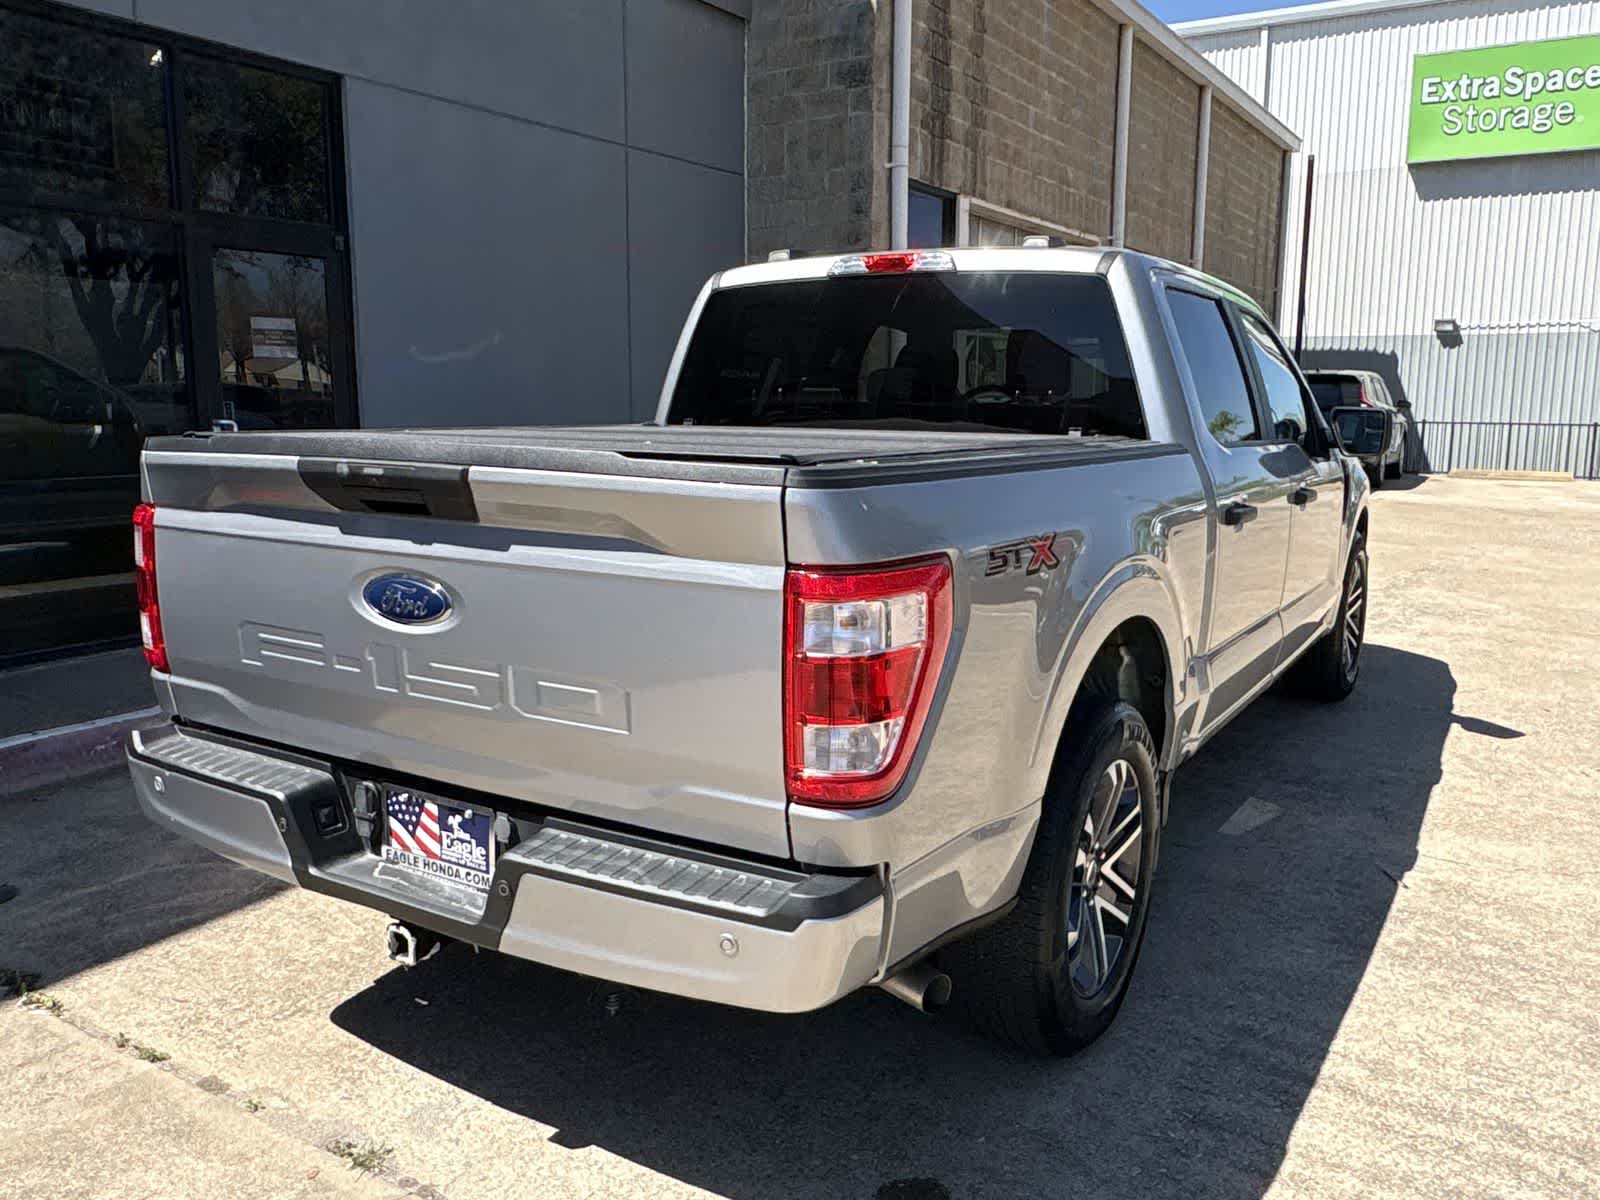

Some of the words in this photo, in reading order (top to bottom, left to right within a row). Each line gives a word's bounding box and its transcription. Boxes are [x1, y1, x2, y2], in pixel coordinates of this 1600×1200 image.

[1442, 101, 1575, 135] Storage
[985, 532, 1060, 577] STX
[381, 583, 429, 617] Ford
[238, 620, 633, 736] F-150
[440, 830, 487, 863] Eagle
[386, 848, 420, 868] EAGLE
[423, 859, 491, 888] HONDA.COM
